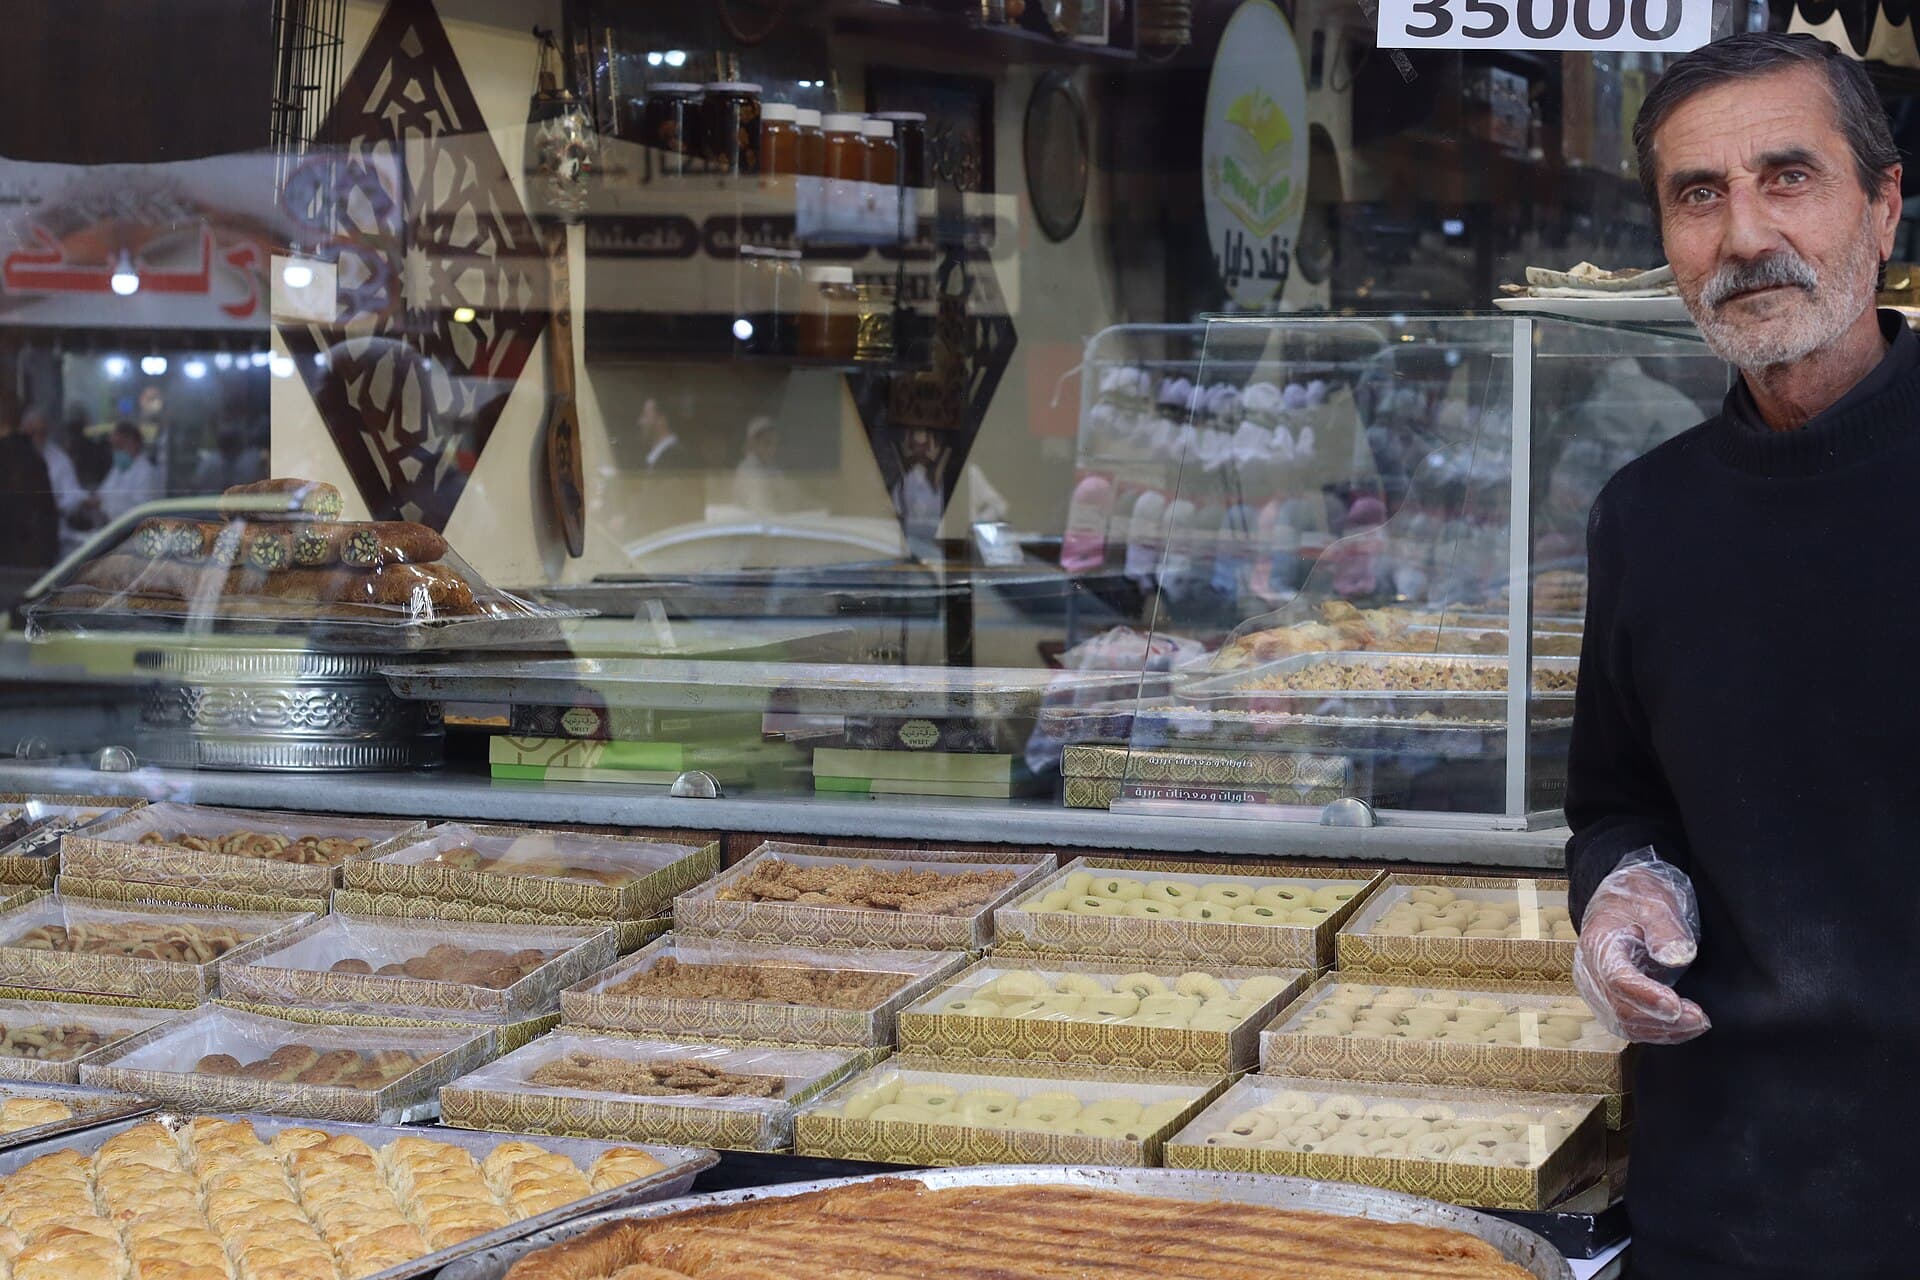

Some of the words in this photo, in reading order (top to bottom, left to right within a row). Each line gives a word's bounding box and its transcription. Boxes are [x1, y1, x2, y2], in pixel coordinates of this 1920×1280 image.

[1405, 0, 1684, 41] 35000
[1135, 787, 1162, 798] عربية
[1165, 789, 1207, 801] معجنات
[1210, 792, 1216, 801] و
[1218, 791, 1255, 802] حلويات
